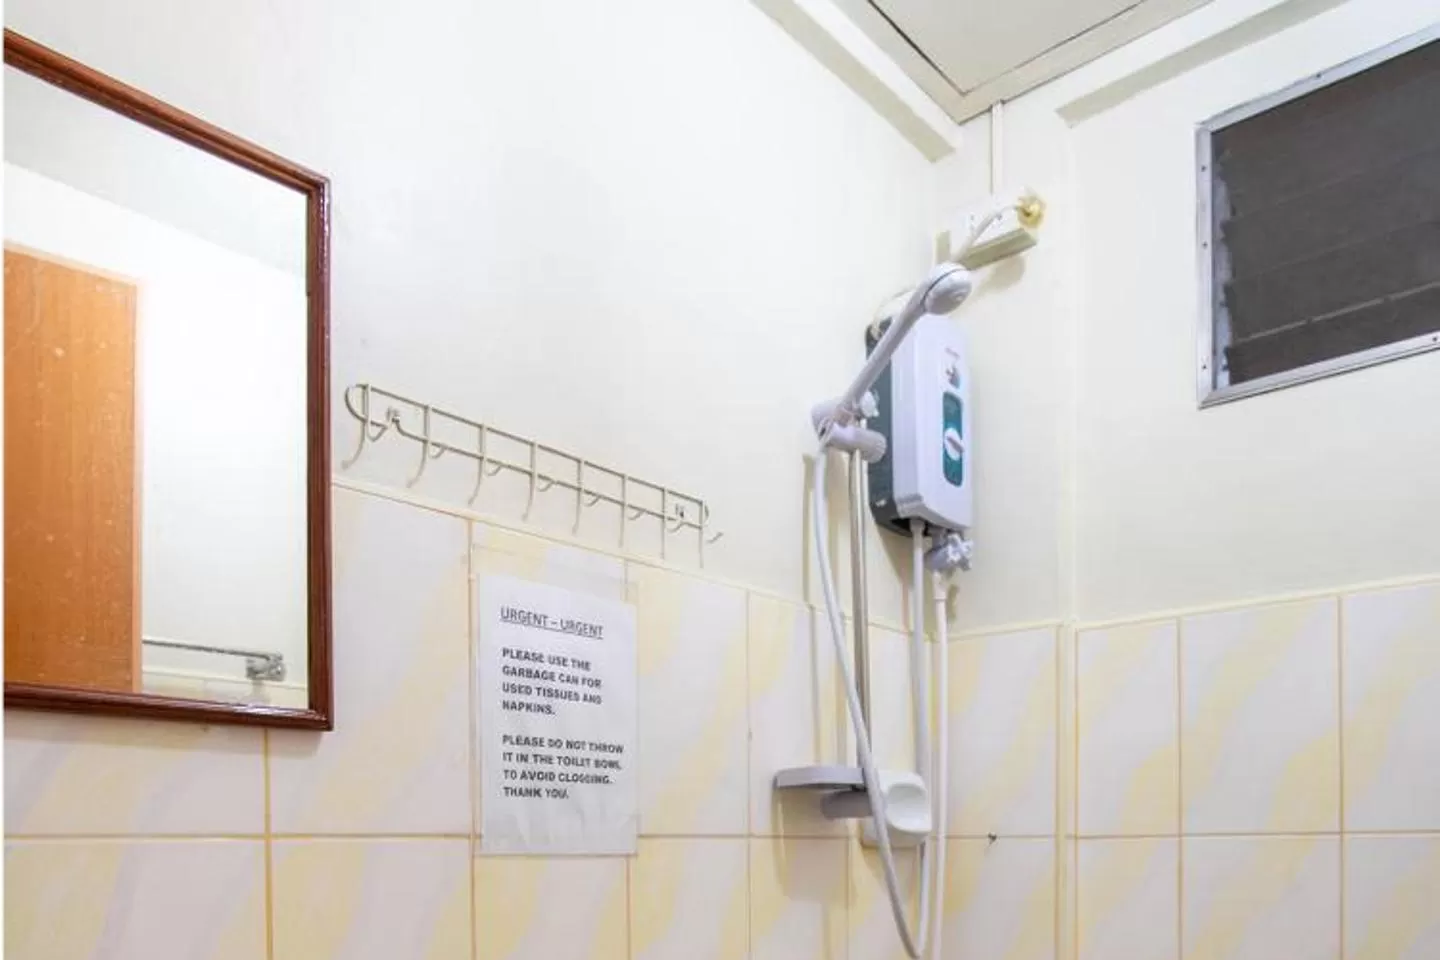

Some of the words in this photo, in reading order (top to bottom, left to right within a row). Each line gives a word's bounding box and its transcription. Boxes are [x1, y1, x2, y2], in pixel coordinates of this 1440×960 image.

[500, 606, 548, 629] URGENT
[560, 618, 603, 640] URGENT
[502, 647, 544, 663] PLEASE
[548, 654, 568, 667] USE
[571, 658, 591, 671] THE
[502, 665, 555, 681] GARBAGE
[559, 673, 578, 685] CAN
[581, 677, 601, 689] FOR
[502, 682, 532, 695] USED
[536, 687, 580, 702] TISSUES
[583, 694, 602, 705] AND
[502, 700, 555, 715] NAPKINS.
[503, 735, 544, 747] PLEASE
[548, 738, 563, 748] DO
[566, 740, 586, 750] NOT
[589, 742, 624, 753] THROW
[503, 787, 542, 797] THANK
[545, 788, 569, 799] YOU.
